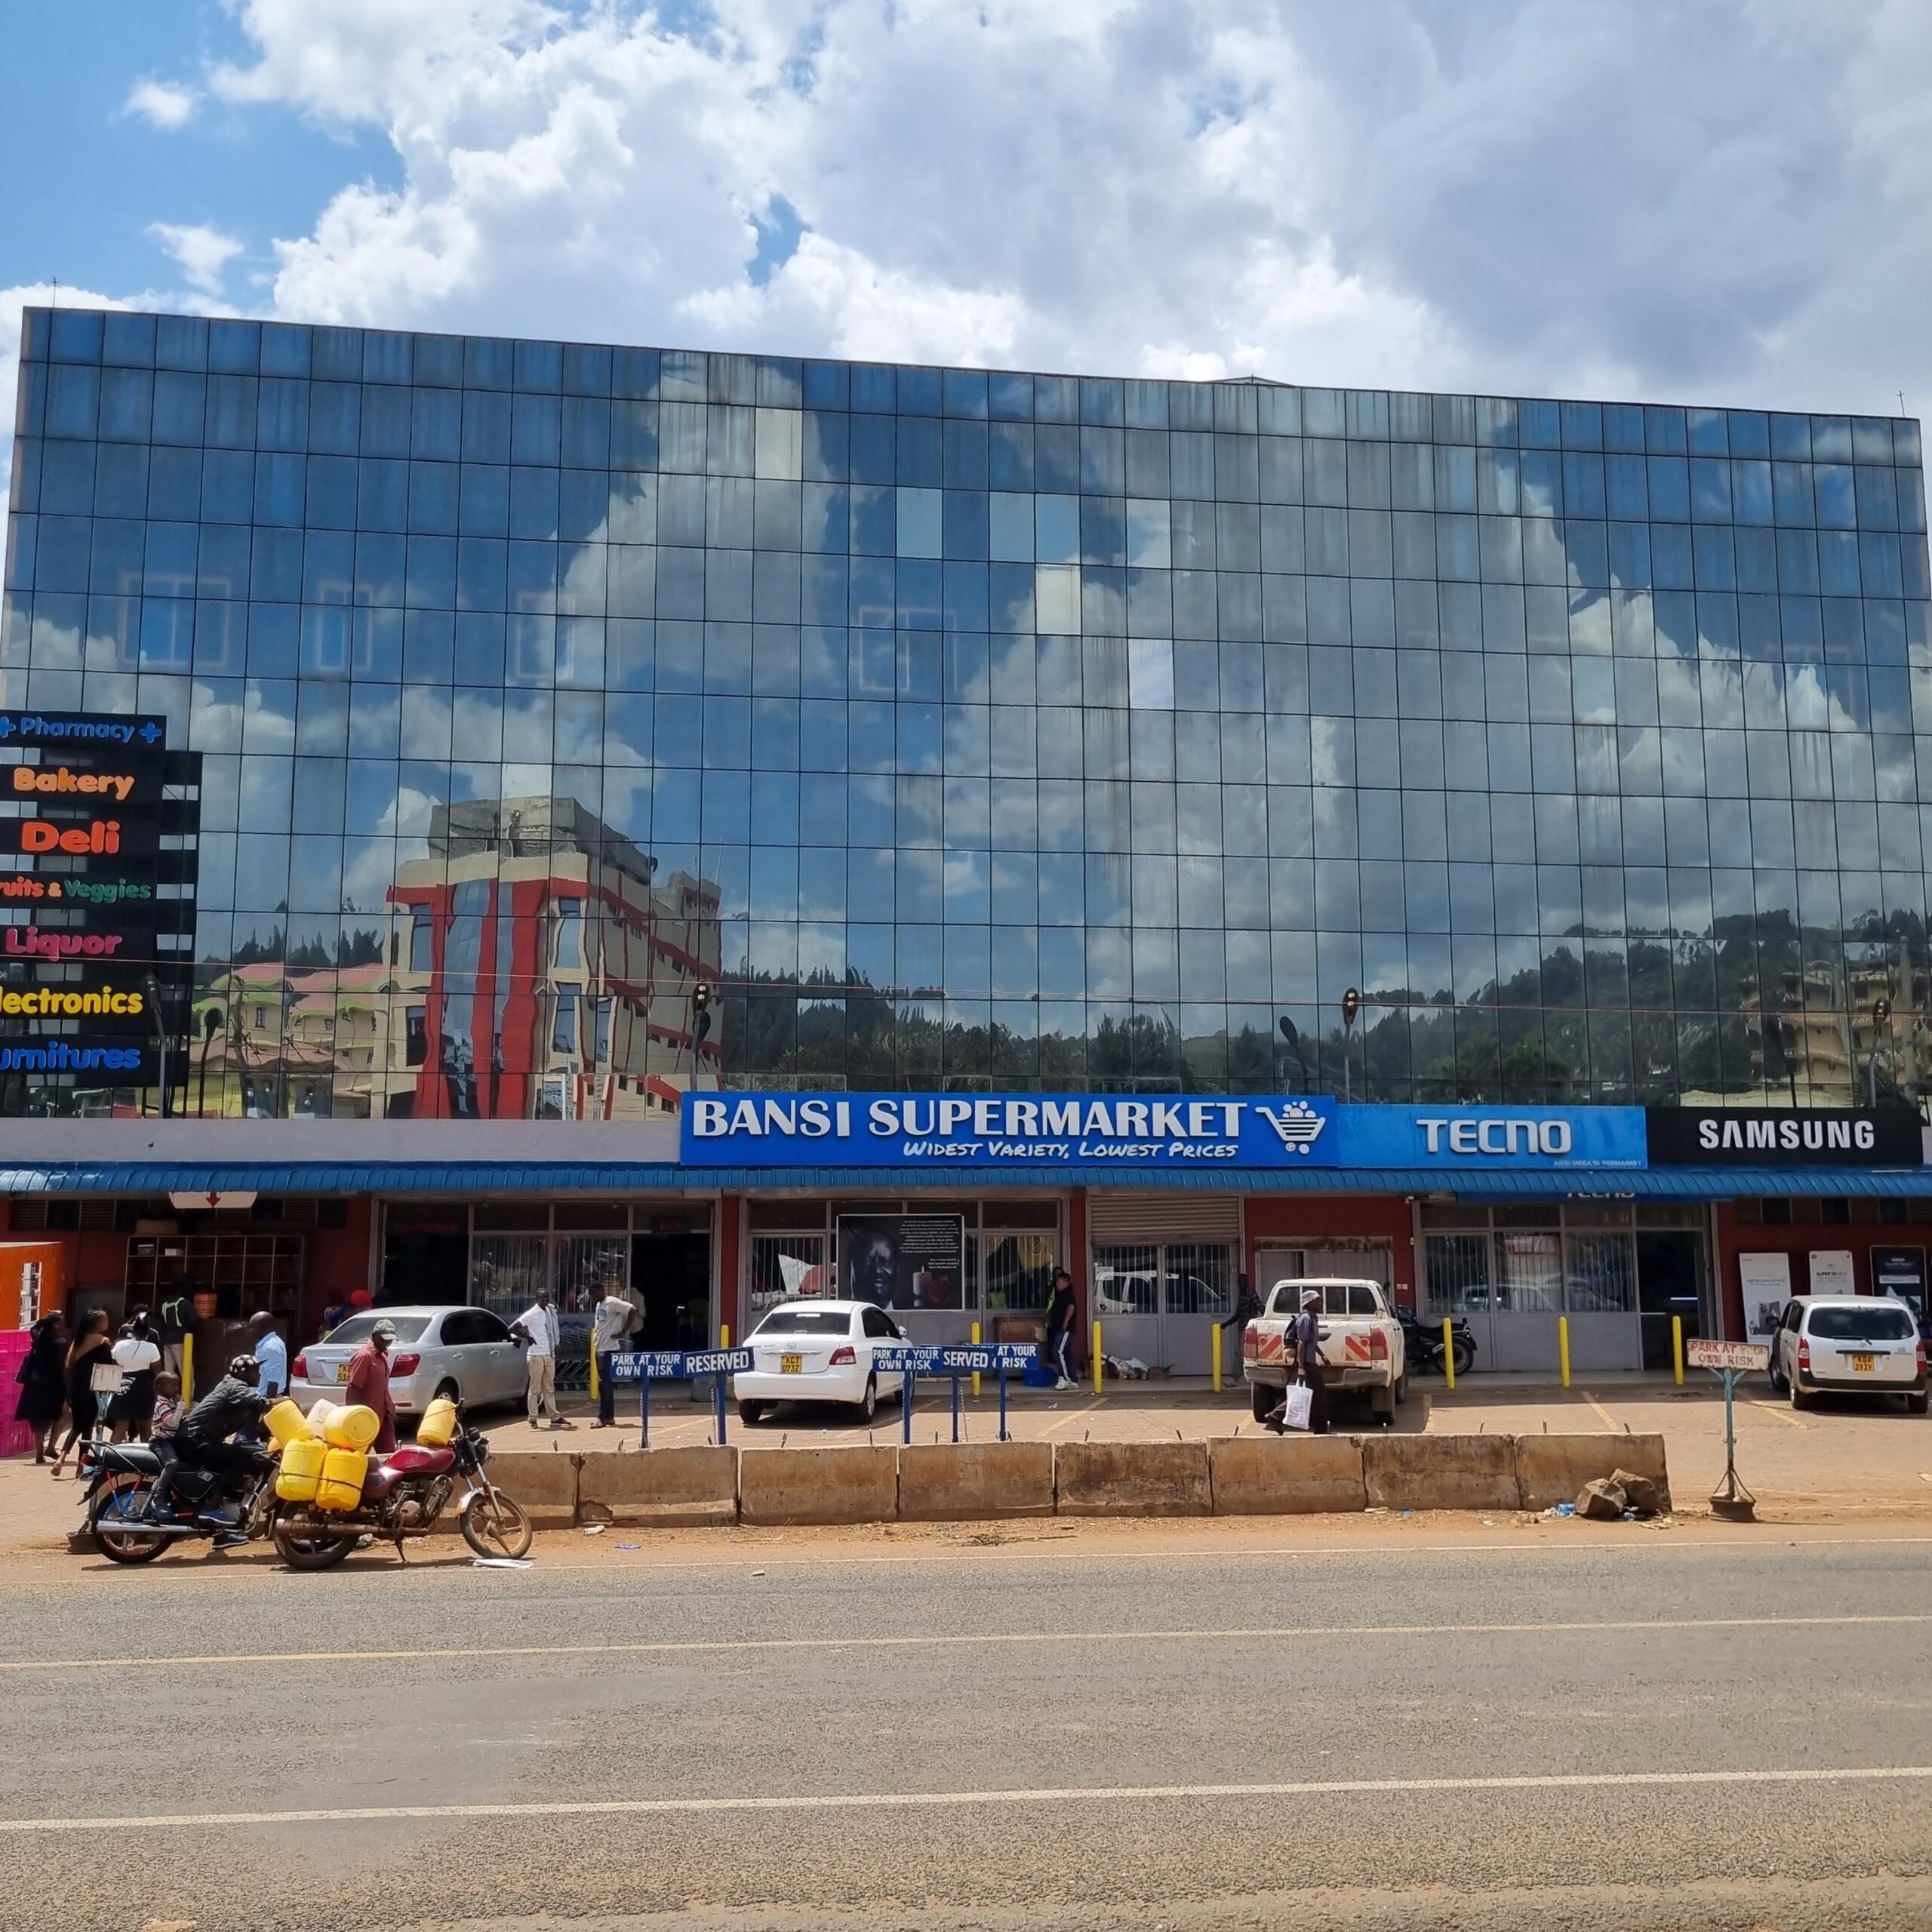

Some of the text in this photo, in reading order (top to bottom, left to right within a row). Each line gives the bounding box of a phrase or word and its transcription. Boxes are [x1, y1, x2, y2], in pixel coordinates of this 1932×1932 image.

[20, 717, 134, 743] Pharmacy
[14, 767, 134, 800] Bakery
[22, 821, 120, 854] Deli
[0, 876, 151, 903] uits & Veggies
[6, 926, 122, 961] Liquor
[0, 986, 143, 1014] ectronics
[0, 1041, 140, 1070] urnitures
[692, 1100, 1247, 1137] BANSI SUPERMARKET
[1417, 1119, 1571, 1153] TECNO
[1699, 1118, 1875, 1149] SAMSUNG
[904, 1142, 1238, 1158] WIDEST VARIETY, LOWEST PRICES
[611, 1353, 680, 1366] PARK AT YOUR
[873, 1349, 940, 1360] PARK AT YOUR
[943, 1351, 989, 1368] SERVED
[997, 1345, 1037, 1357] AT YOUR
[1689, 1343, 1719, 1352] PARK
[1722, 1344, 1737, 1353] AT
[1698, 1353, 1754, 1366] OWN RISK
[616, 1364, 674, 1376] OWN RISK
[686, 1351, 749, 1374] RESERVED
[878, 1359, 932, 1370] OWN RISK
[1002, 1357, 1027, 1368] RISK
